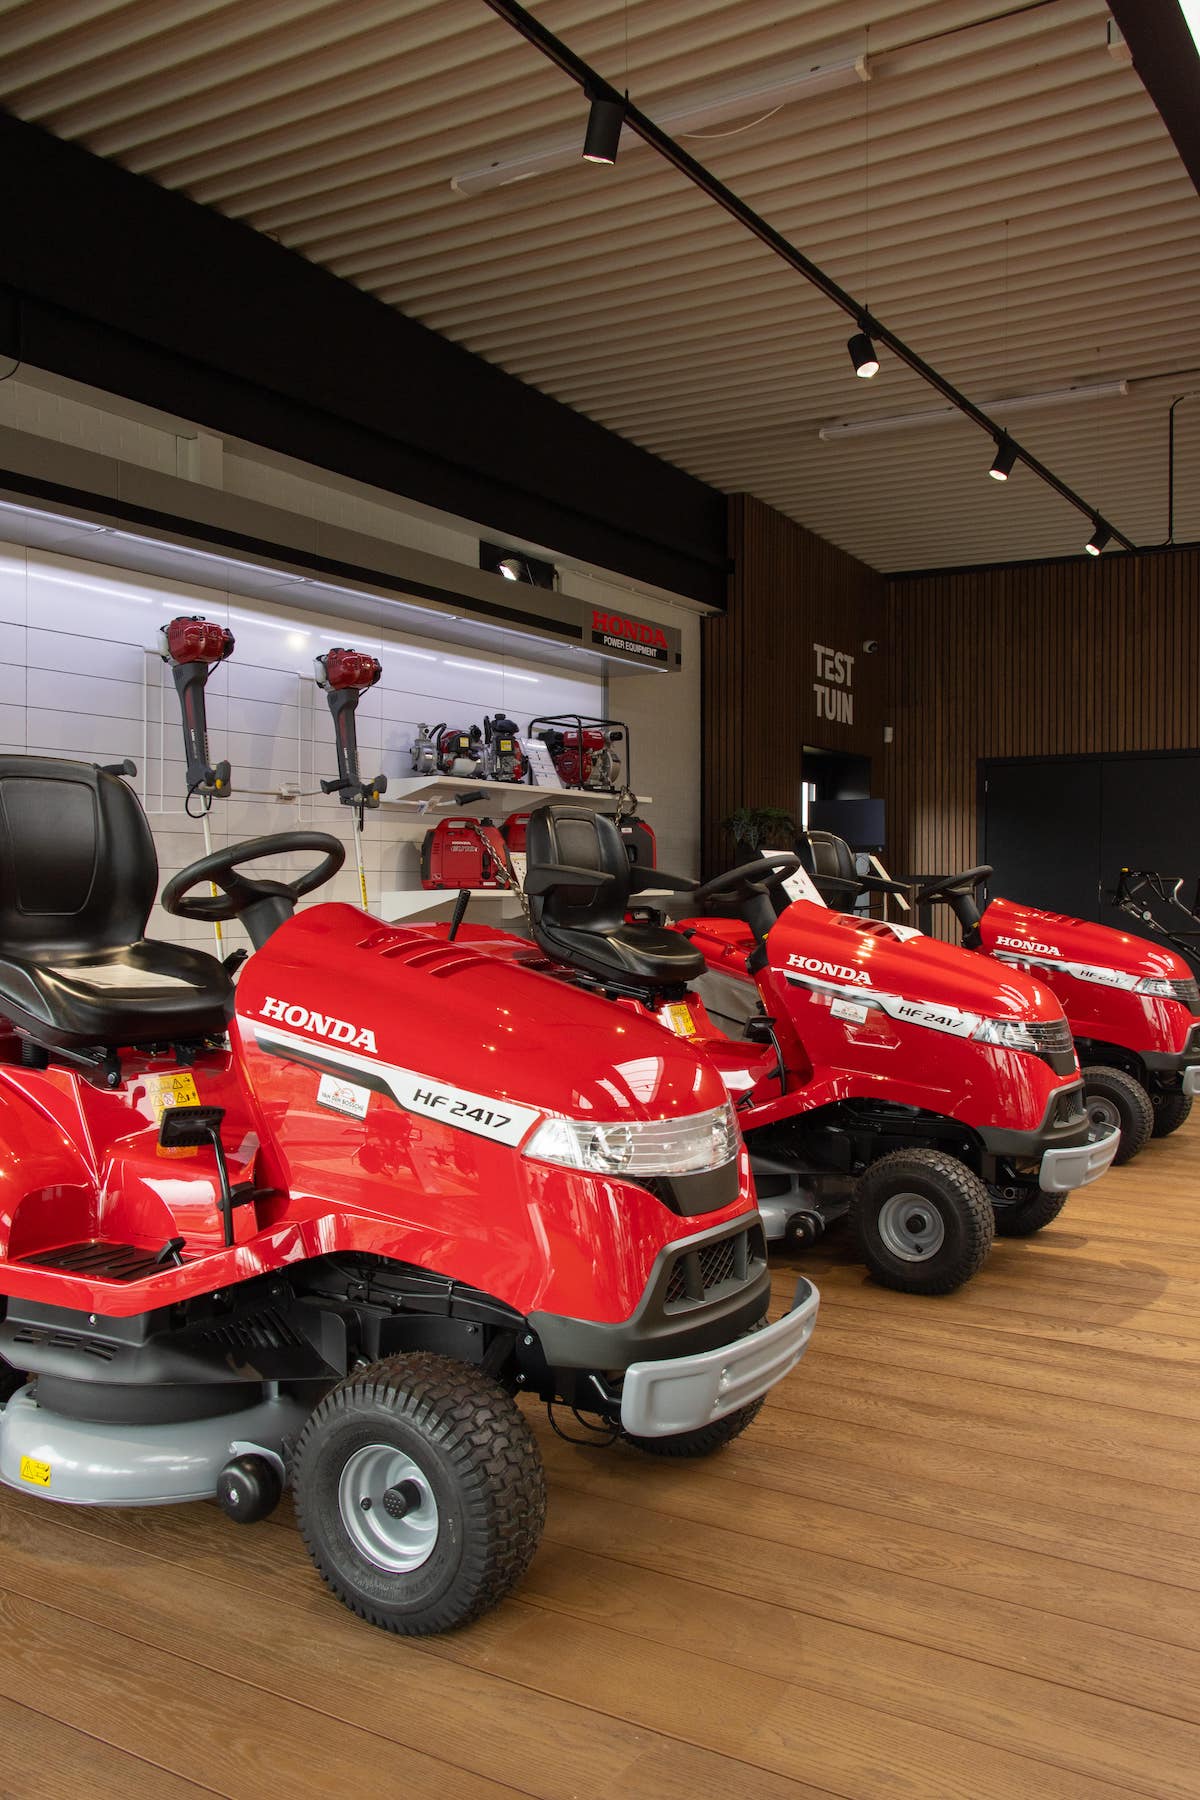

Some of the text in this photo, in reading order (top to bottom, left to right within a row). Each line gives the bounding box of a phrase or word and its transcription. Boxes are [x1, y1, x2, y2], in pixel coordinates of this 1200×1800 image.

[592, 610, 668, 649] HONDA
[603, 635, 657, 657] POWER EQUIPMENT
[813, 643, 854, 687] TEST
[813, 683, 853, 725] TUIN
[995, 935, 1062, 956] HONDA
[786, 953, 873, 985] HONDA
[1080, 970, 1096, 978] HF
[259, 996, 378, 1054] HONDA
[898, 1006, 964, 1028] HF 2417
[413, 1088, 512, 1128] HF 2417
